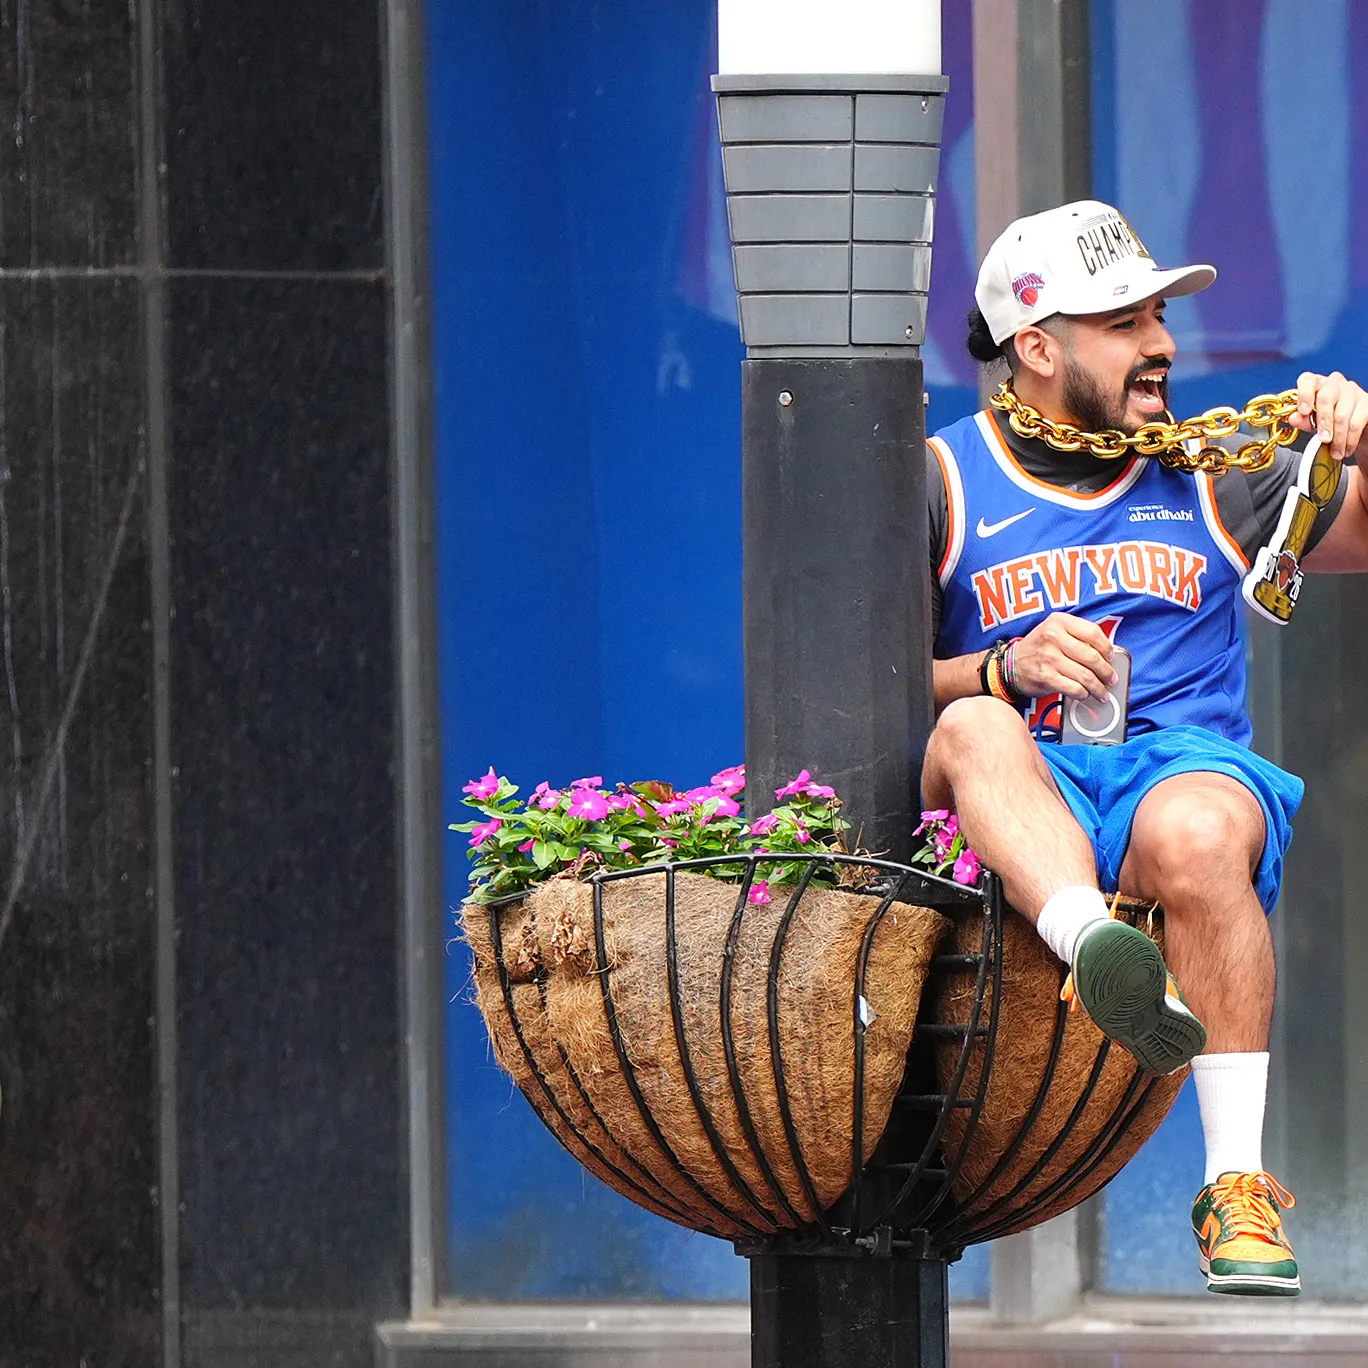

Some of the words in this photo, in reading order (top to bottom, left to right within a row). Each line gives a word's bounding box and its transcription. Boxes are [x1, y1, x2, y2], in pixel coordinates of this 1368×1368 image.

[1129, 511, 1156, 522] abu
[1156, 509, 1194, 521] dhabi
[970, 545, 1080, 632] NEW
[1083, 540, 1207, 613] YORK
